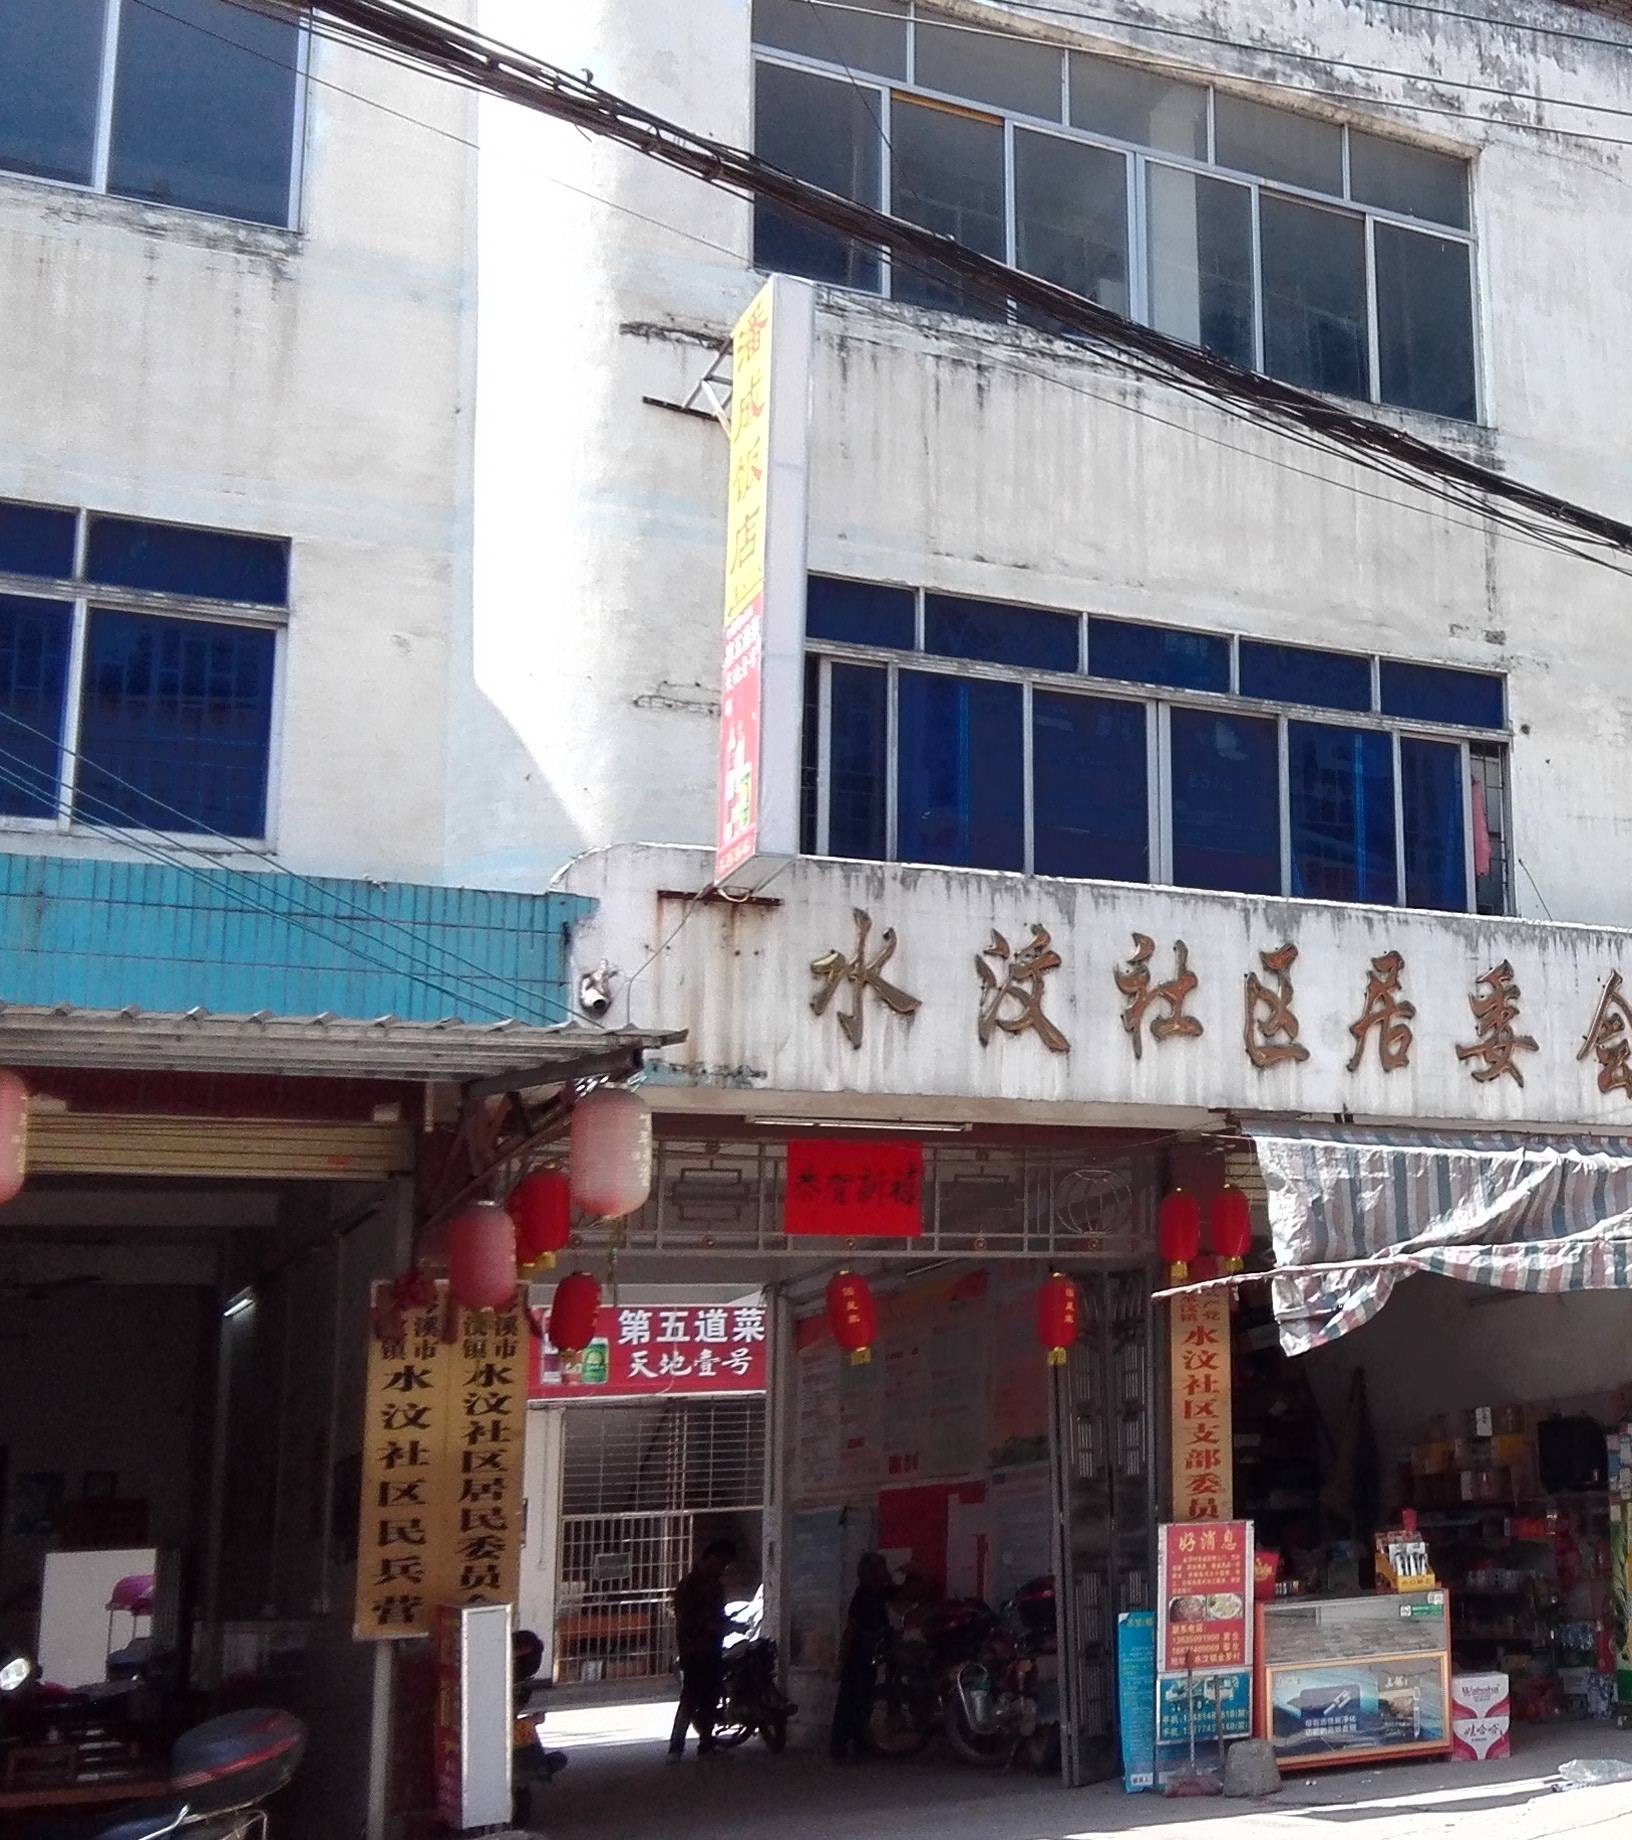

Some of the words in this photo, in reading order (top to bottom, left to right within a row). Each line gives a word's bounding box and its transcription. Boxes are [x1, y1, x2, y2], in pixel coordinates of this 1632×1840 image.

[618, 1308, 766, 1345] 第五道菜
[628, 1348, 753, 1378] 天地壹号
[372, 1364, 434, 1624] 水汶社区民兵营
[1179, 1529, 1237, 1552] 好消息
